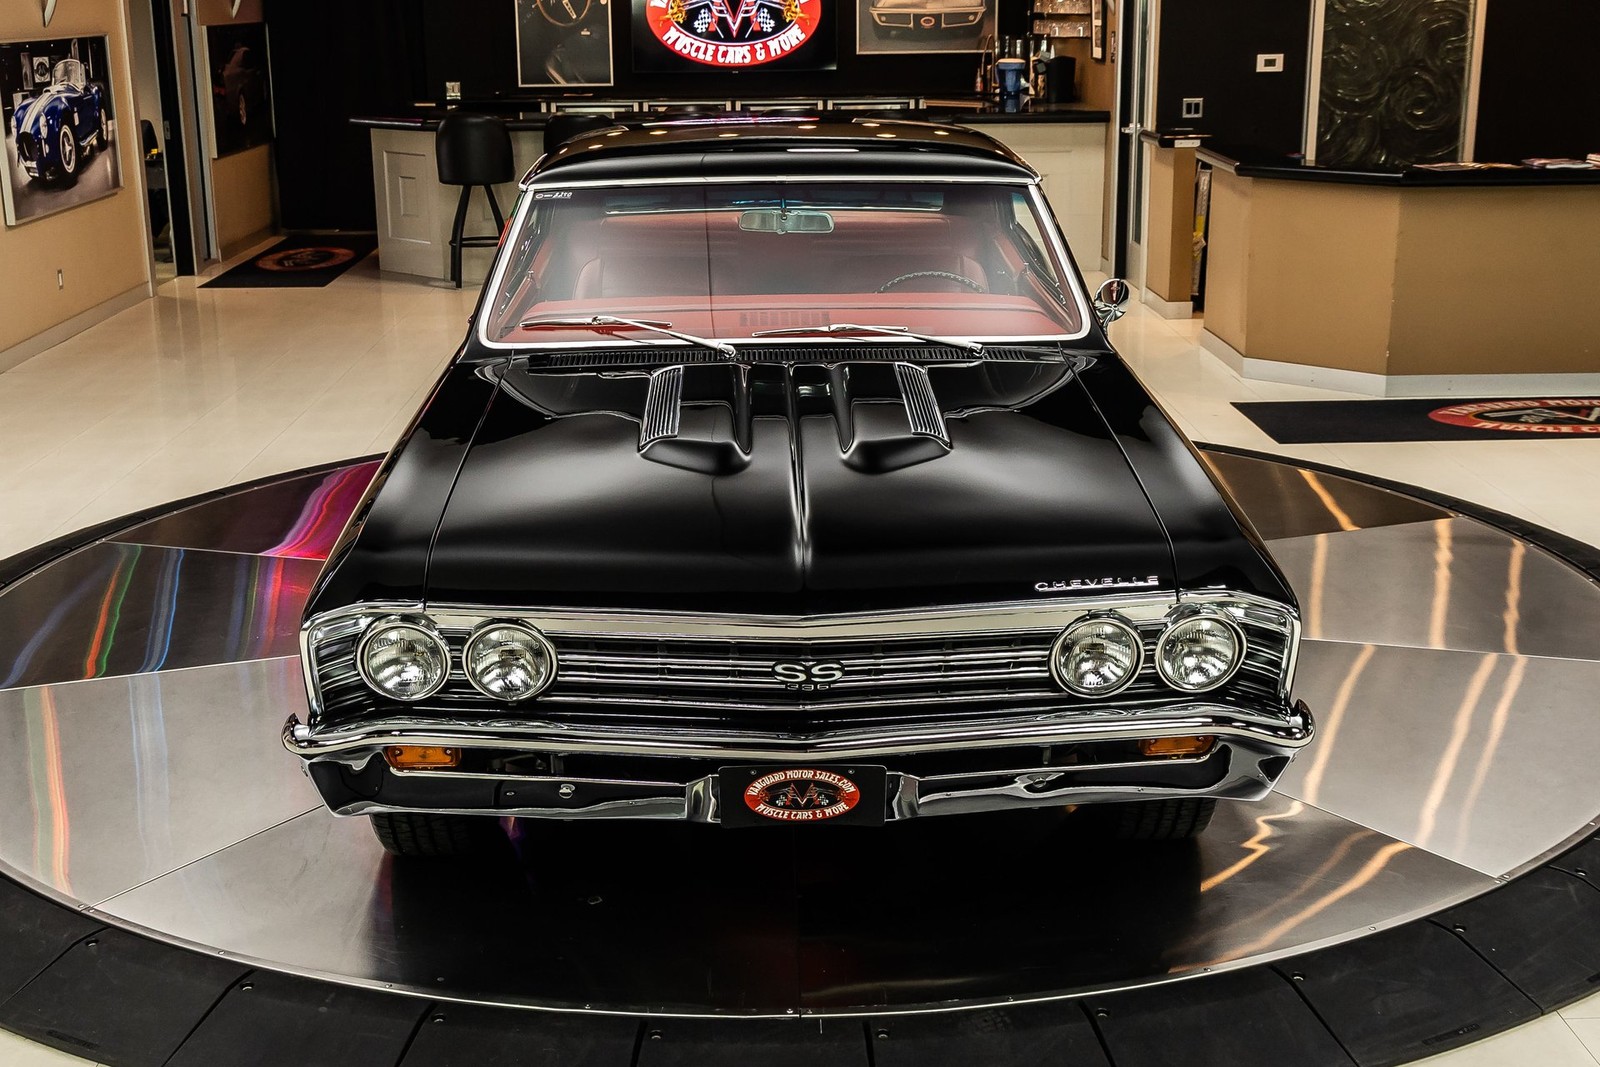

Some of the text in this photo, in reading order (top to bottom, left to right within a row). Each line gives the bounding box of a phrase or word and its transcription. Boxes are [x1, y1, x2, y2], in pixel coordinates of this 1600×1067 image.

[662, 23, 807, 64] MUSCLE CARS & MORE
[1473, 422, 1572, 433] MUSCLE
[1034, 575, 1159, 592] CHEVELLE
[774, 663, 843, 682] SS
[747, 769, 856, 796] VANGUARD MOTOR SALES.COM
[754, 802, 850, 820] MUSCLE CARS & MORE
